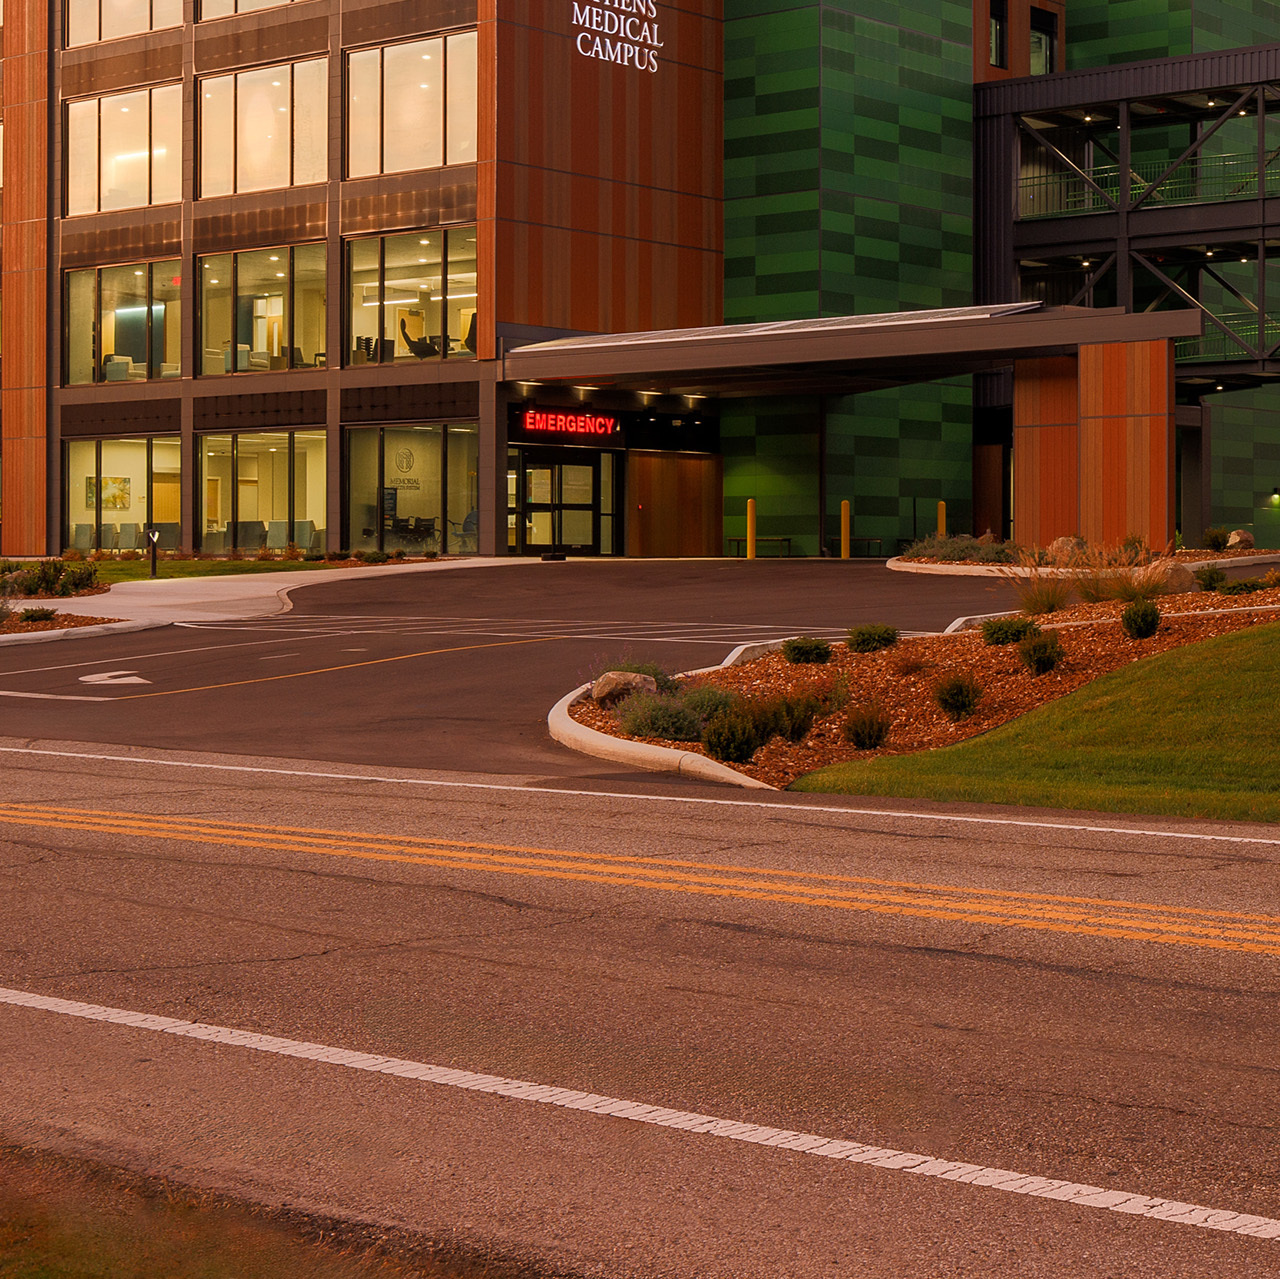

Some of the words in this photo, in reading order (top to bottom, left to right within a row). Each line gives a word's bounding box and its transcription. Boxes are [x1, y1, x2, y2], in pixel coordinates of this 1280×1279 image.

[571, 1, 664, 48] MEDICAL
[576, 32, 659, 73] CAMPUS
[525, 412, 615, 434] EMERGENCY
